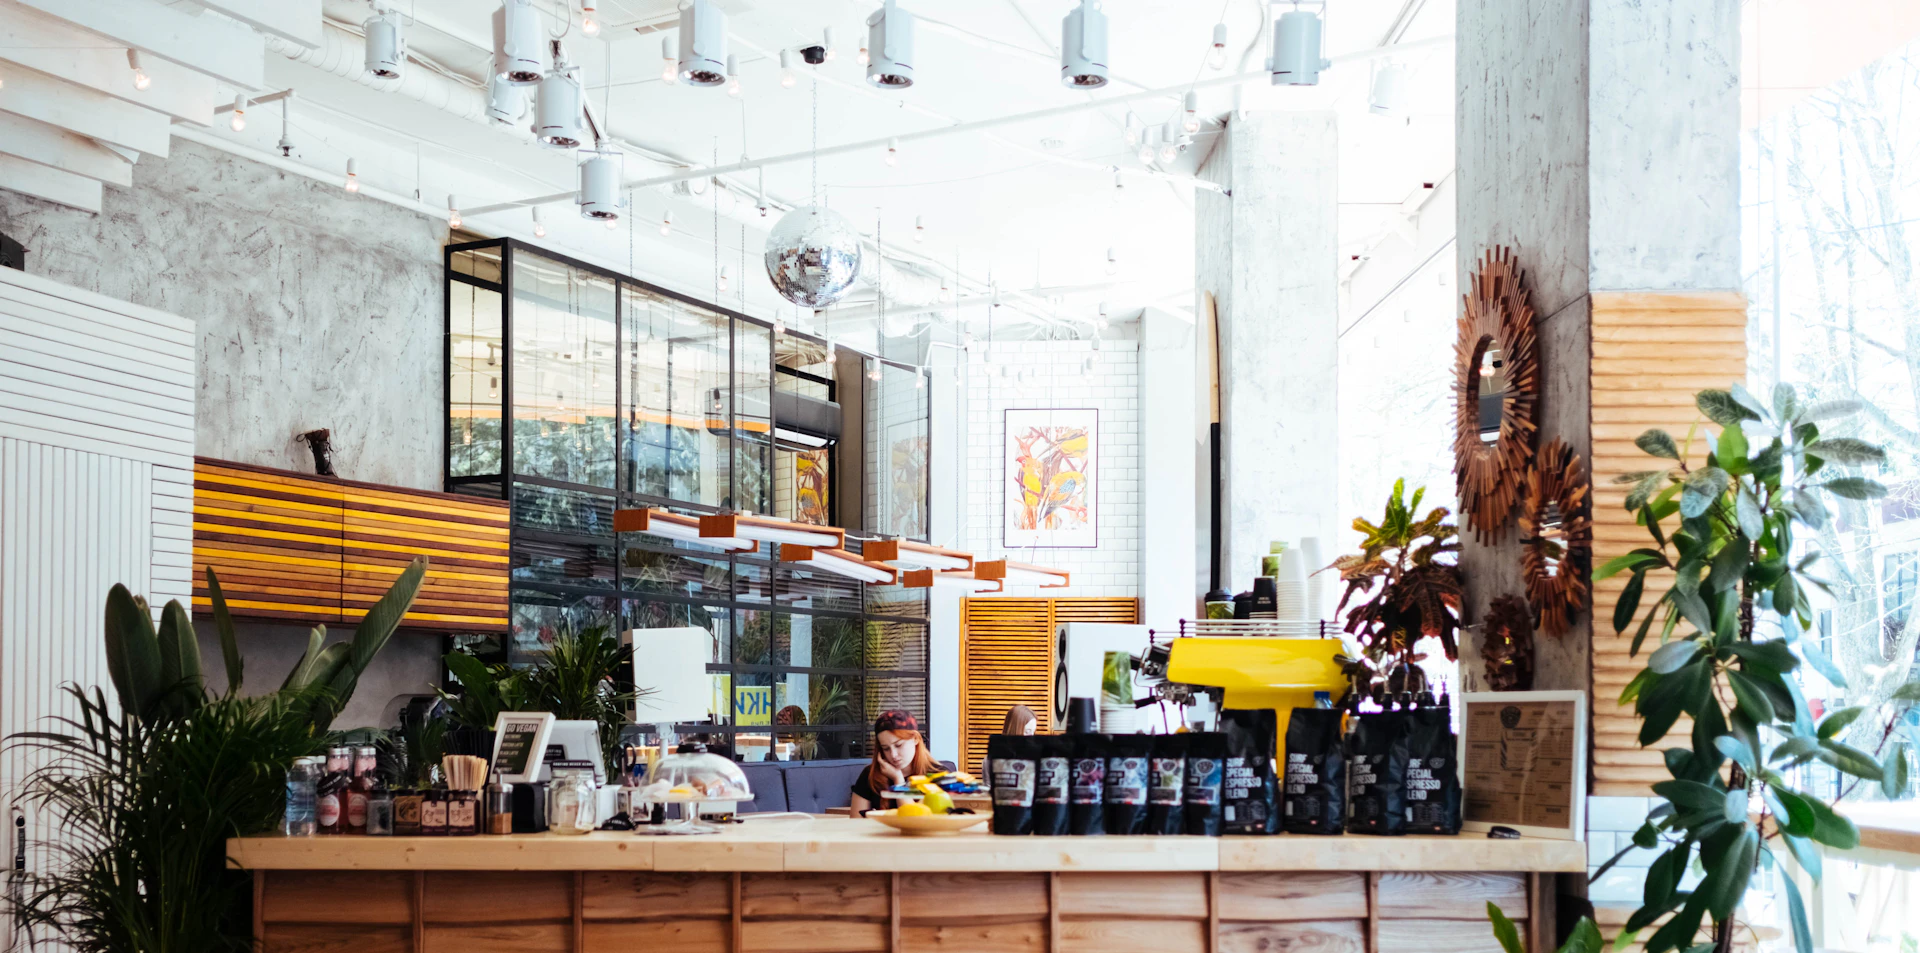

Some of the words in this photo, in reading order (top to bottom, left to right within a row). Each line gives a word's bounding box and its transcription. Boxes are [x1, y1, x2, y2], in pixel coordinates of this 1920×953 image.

[507, 724, 516, 732] GO
[516, 724, 537, 732] VEGAN
[1226, 757, 1245, 767] SURF
[1289, 753, 1308, 763] SURF
[1226, 767, 1254, 778] SPECIAL
[1288, 763, 1314, 774] SPECIAL
[1406, 768, 1433, 779] PECIAL
[1225, 776, 1262, 788] ESPRESSO
[1287, 773, 1319, 784] ESPRESSO
[1406, 779, 1441, 790] SPRESSO
[1225, 788, 1249, 799] BLEND
[1406, 789, 1428, 800] LEND
